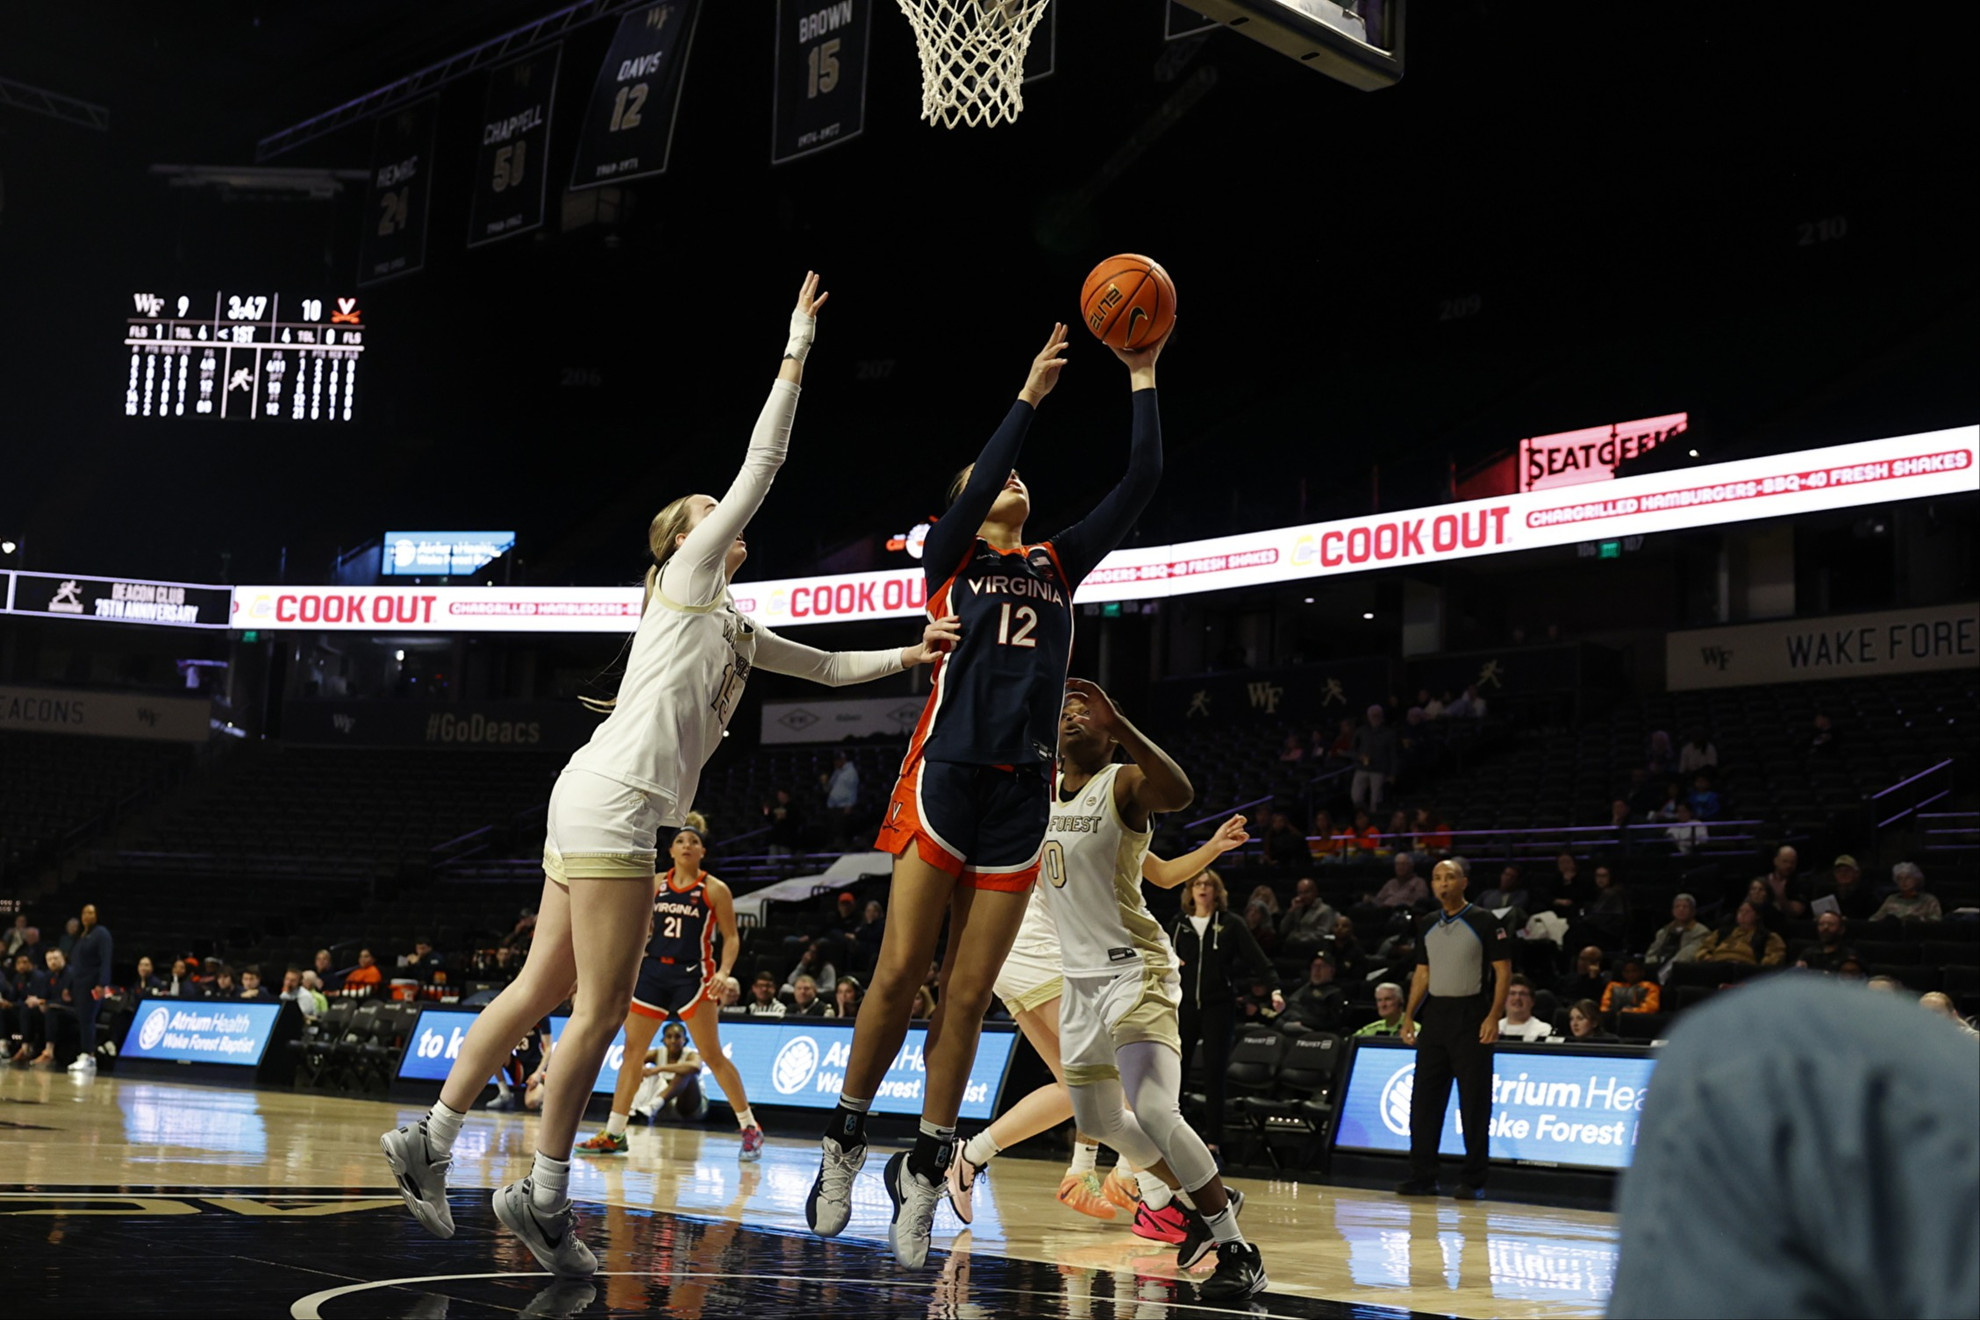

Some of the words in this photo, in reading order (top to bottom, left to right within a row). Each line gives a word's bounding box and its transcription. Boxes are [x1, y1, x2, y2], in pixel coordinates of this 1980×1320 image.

[799, 0, 853, 45] BROWN
[616, 50, 663, 82] DAVIS
[807, 38, 841, 100] 15
[609, 82, 650, 132] 12
[492, 139, 527, 193] 50
[178, 296, 189, 317] 9
[228, 296, 267, 319] 3:47
[302, 300, 321, 321] 10
[1089, 287, 1123, 331] ELITE
[129, 326, 148, 338] FLS
[156, 324, 163, 339] 1
[198, 325, 207, 340] 4
[232, 326, 255, 343] 1ST
[281, 328, 290, 343] 4
[343, 332, 361, 344] FLS
[1529, 499, 1638, 526] CHARGRILLED
[1830, 463, 1889, 485] FRESH
[1892, 452, 1968, 477] SHAKES
[1320, 518, 1425, 568] COOK
[1432, 506, 1511, 553] OUT
[1188, 557, 1227, 574] FRESH
[1228, 550, 1277, 569] SHAKES
[112, 583, 156, 602] BEACON
[156, 586, 185, 605] CLUB
[790, 581, 876, 618] COOK
[968, 576, 1064, 608] VIRGINIA
[125, 601, 198, 623] ANNIVERSARY
[275, 594, 367, 623] COOK
[372, 594, 438, 623] OUT
[997, 601, 1039, 648] 12
[1786, 628, 1877, 668] WAKE
[1889, 617, 1975, 660] FORE
[1247, 682, 1283, 715] WF
[425, 712, 541, 743] #GoDeacs
[1049, 816, 1102, 833] FOREST
[654, 902, 700, 918] VIRGINIA
[663, 916, 683, 939] 21
[169, 1010, 210, 1032] Atrium
[210, 1013, 251, 1034] Health
[163, 1033, 187, 1050] Wake
[188, 1034, 218, 1051] Forest
[417, 1028, 444, 1059] to
[1535, 1113, 1625, 1146] Forest
